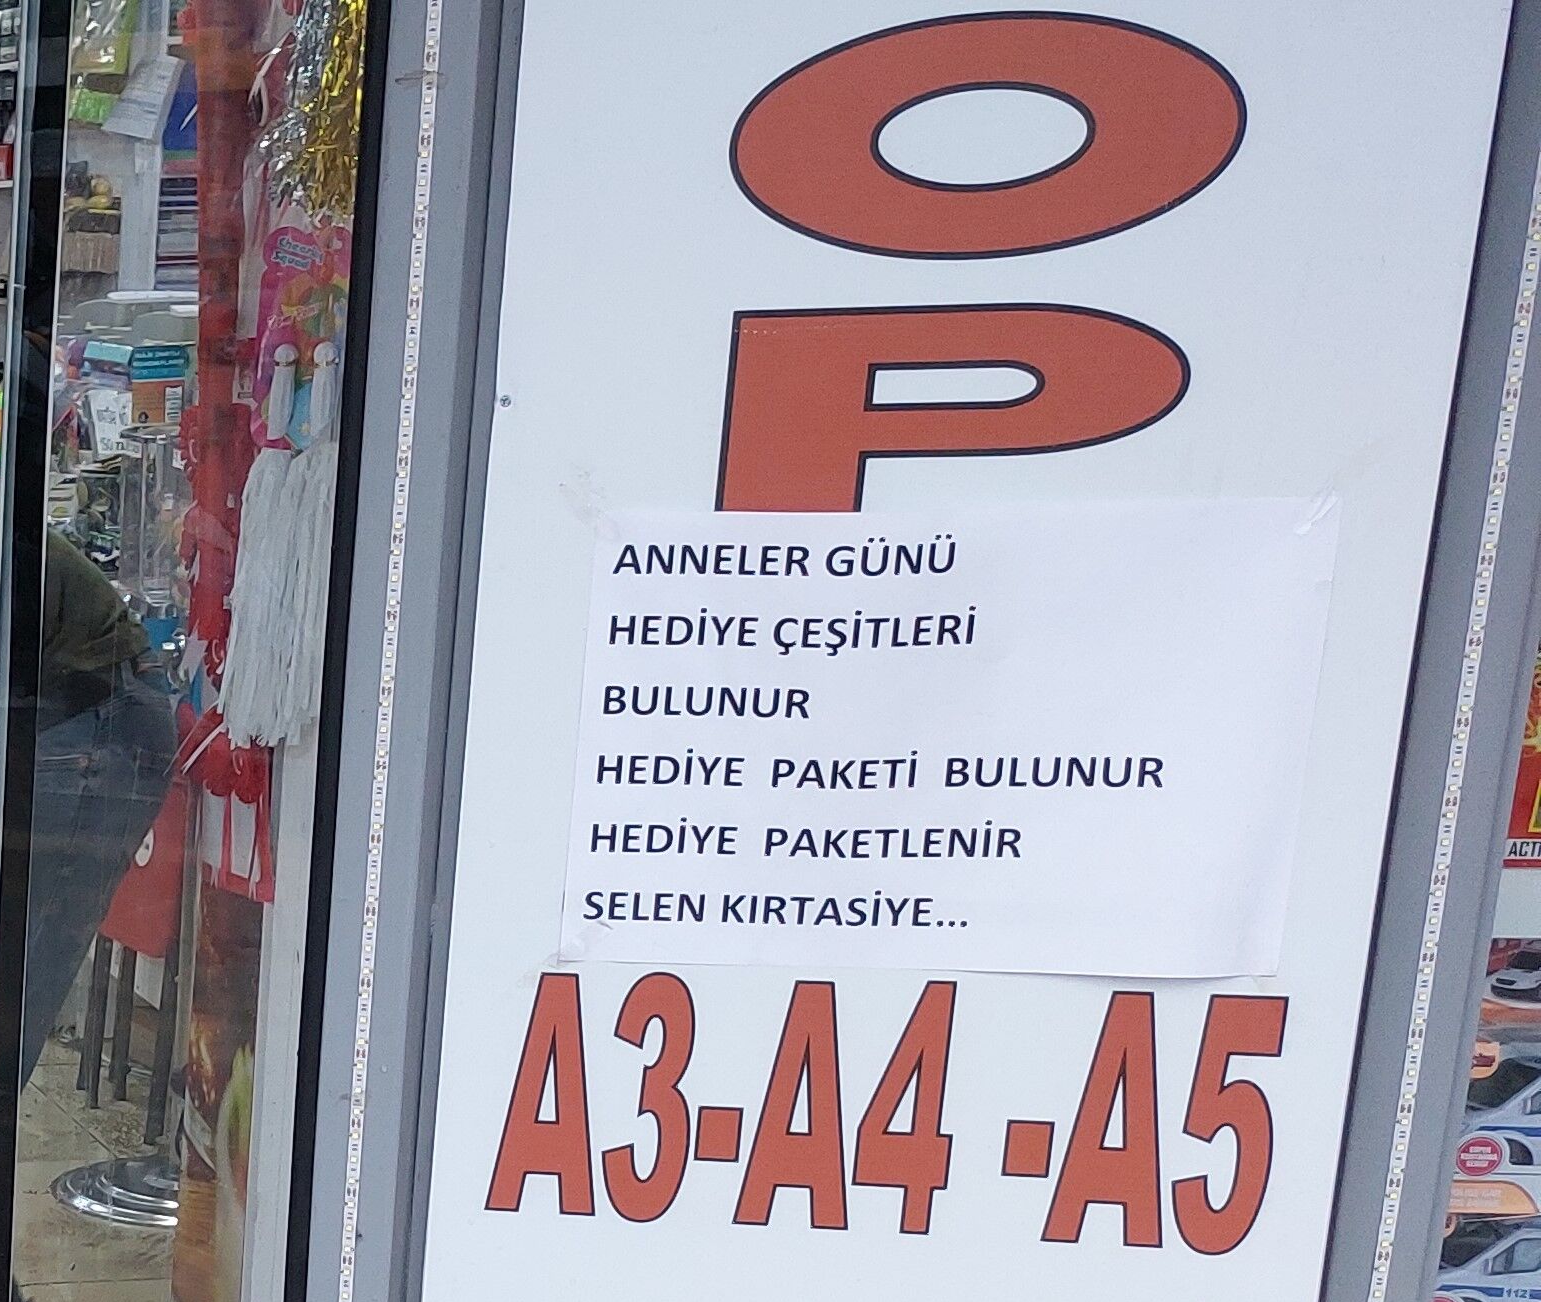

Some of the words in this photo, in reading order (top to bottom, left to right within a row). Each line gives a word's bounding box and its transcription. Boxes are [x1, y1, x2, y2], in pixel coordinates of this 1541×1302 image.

[613, 545, 810, 577] ANNELER
[825, 534, 956, 577] GÜNÜ
[608, 609, 758, 649] HEDİYE
[772, 606, 977, 657] ÇEŞİTLERİ
[603, 685, 810, 719] BULUNUR
[596, 749, 745, 787] HEDİYE
[771, 750, 918, 790] PAKETİ
[944, 756, 1164, 788] BULUNUR
[590, 818, 738, 855] HEDİYE
[764, 821, 1021, 859] PAKETLENİR
[583, 891, 706, 922] SELEN
[721, 890, 968, 928] KIRTASİYE...
